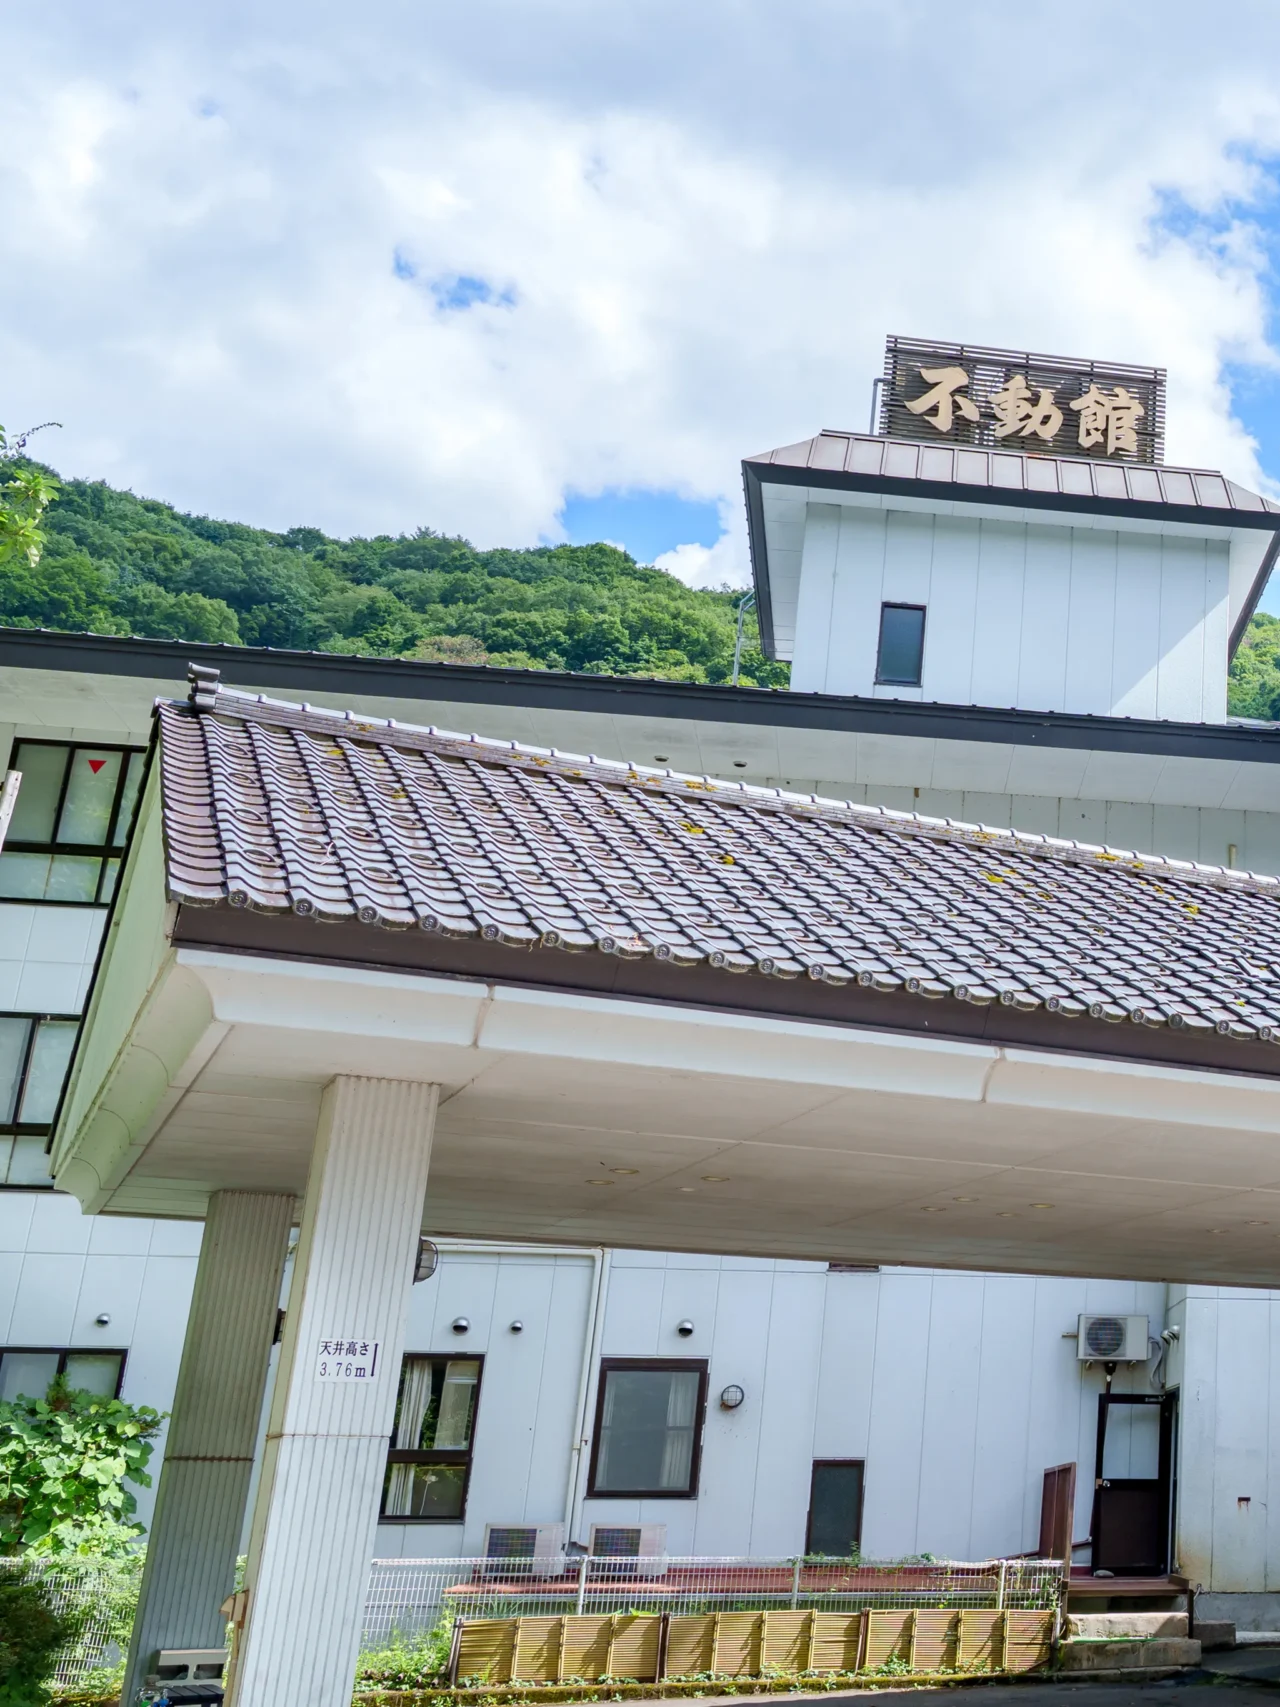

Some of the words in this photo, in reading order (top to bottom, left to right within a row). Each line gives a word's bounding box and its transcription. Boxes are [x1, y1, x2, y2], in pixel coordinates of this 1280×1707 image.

[904, 367, 1145, 455] 不動館
[319, 1340, 370, 1356] 天井高さ
